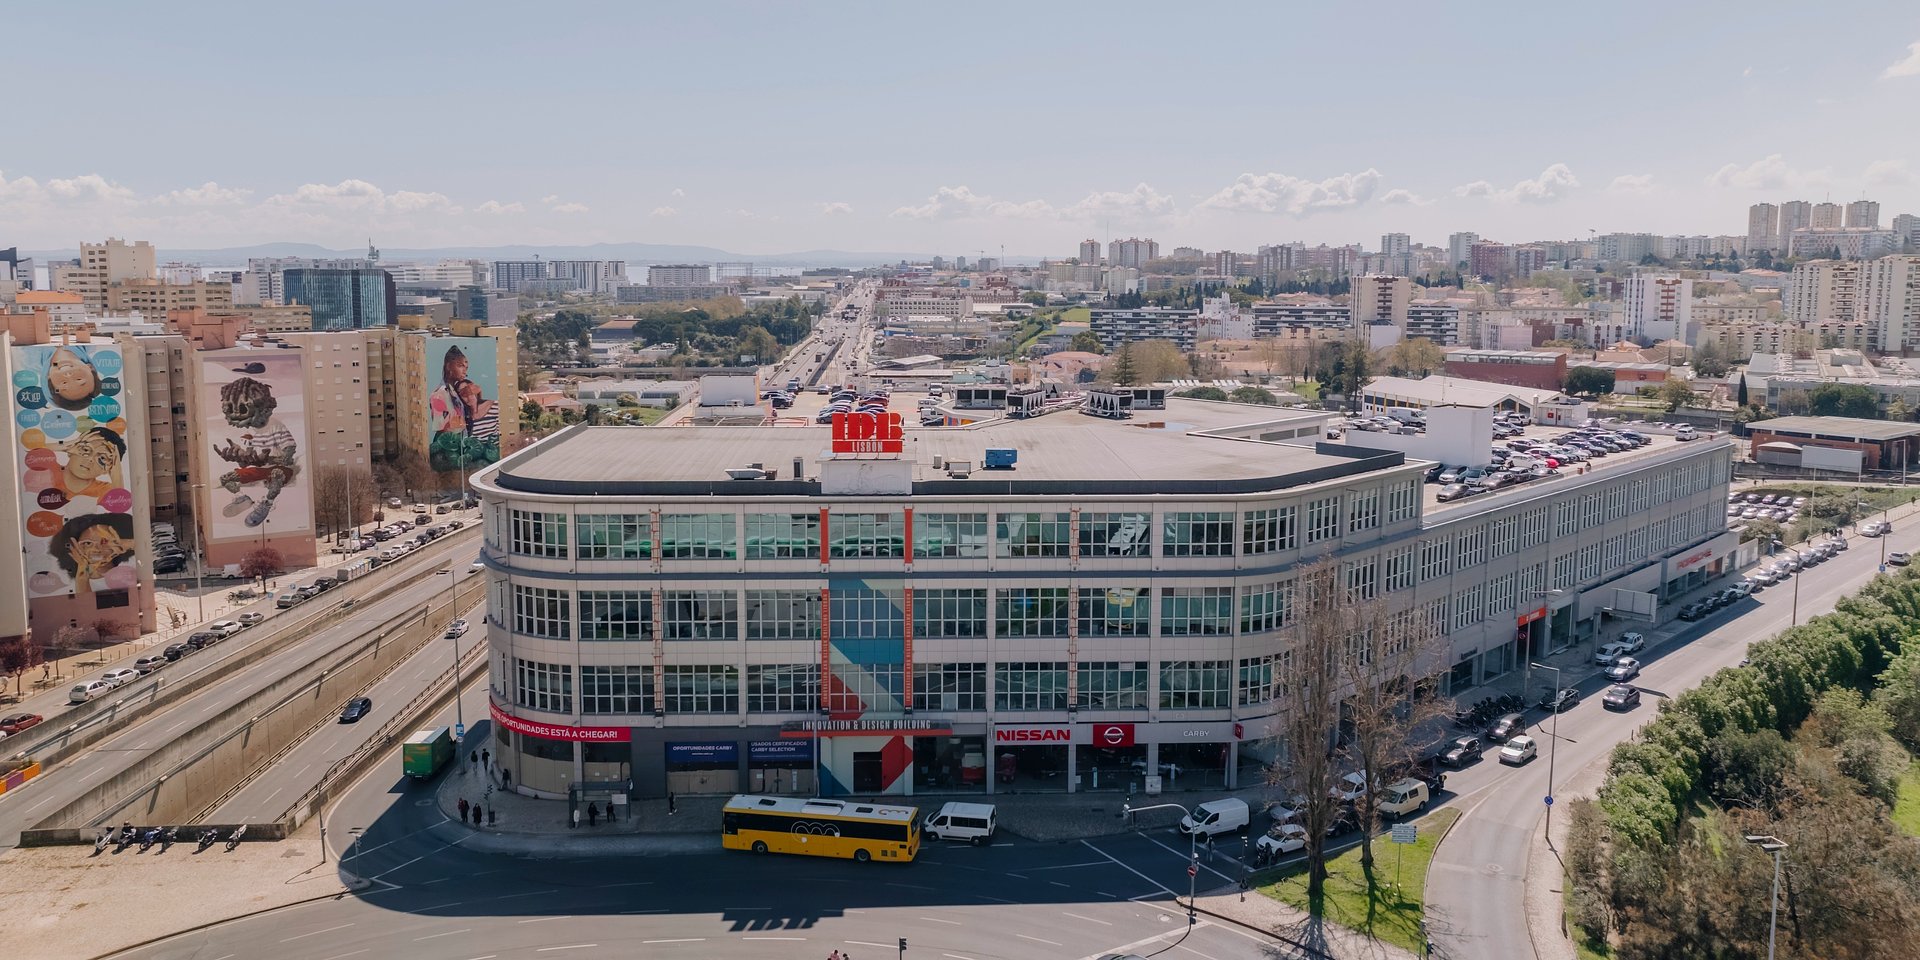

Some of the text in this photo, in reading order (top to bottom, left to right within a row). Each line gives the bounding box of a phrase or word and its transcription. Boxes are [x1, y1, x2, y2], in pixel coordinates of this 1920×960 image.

[832, 413, 903, 440] IDB
[852, 441, 883, 452] LISBON
[501, 715, 549, 736] OPORTUNIDADES
[551, 727, 570, 738] ESTÁ
[579, 730, 618, 739] CHEGAR!
[853, 720, 859, 730] &
[861, 719, 890, 731] DESIGN
[893, 719, 931, 730] BUILDING
[996, 729, 1071, 741] NISSAN
